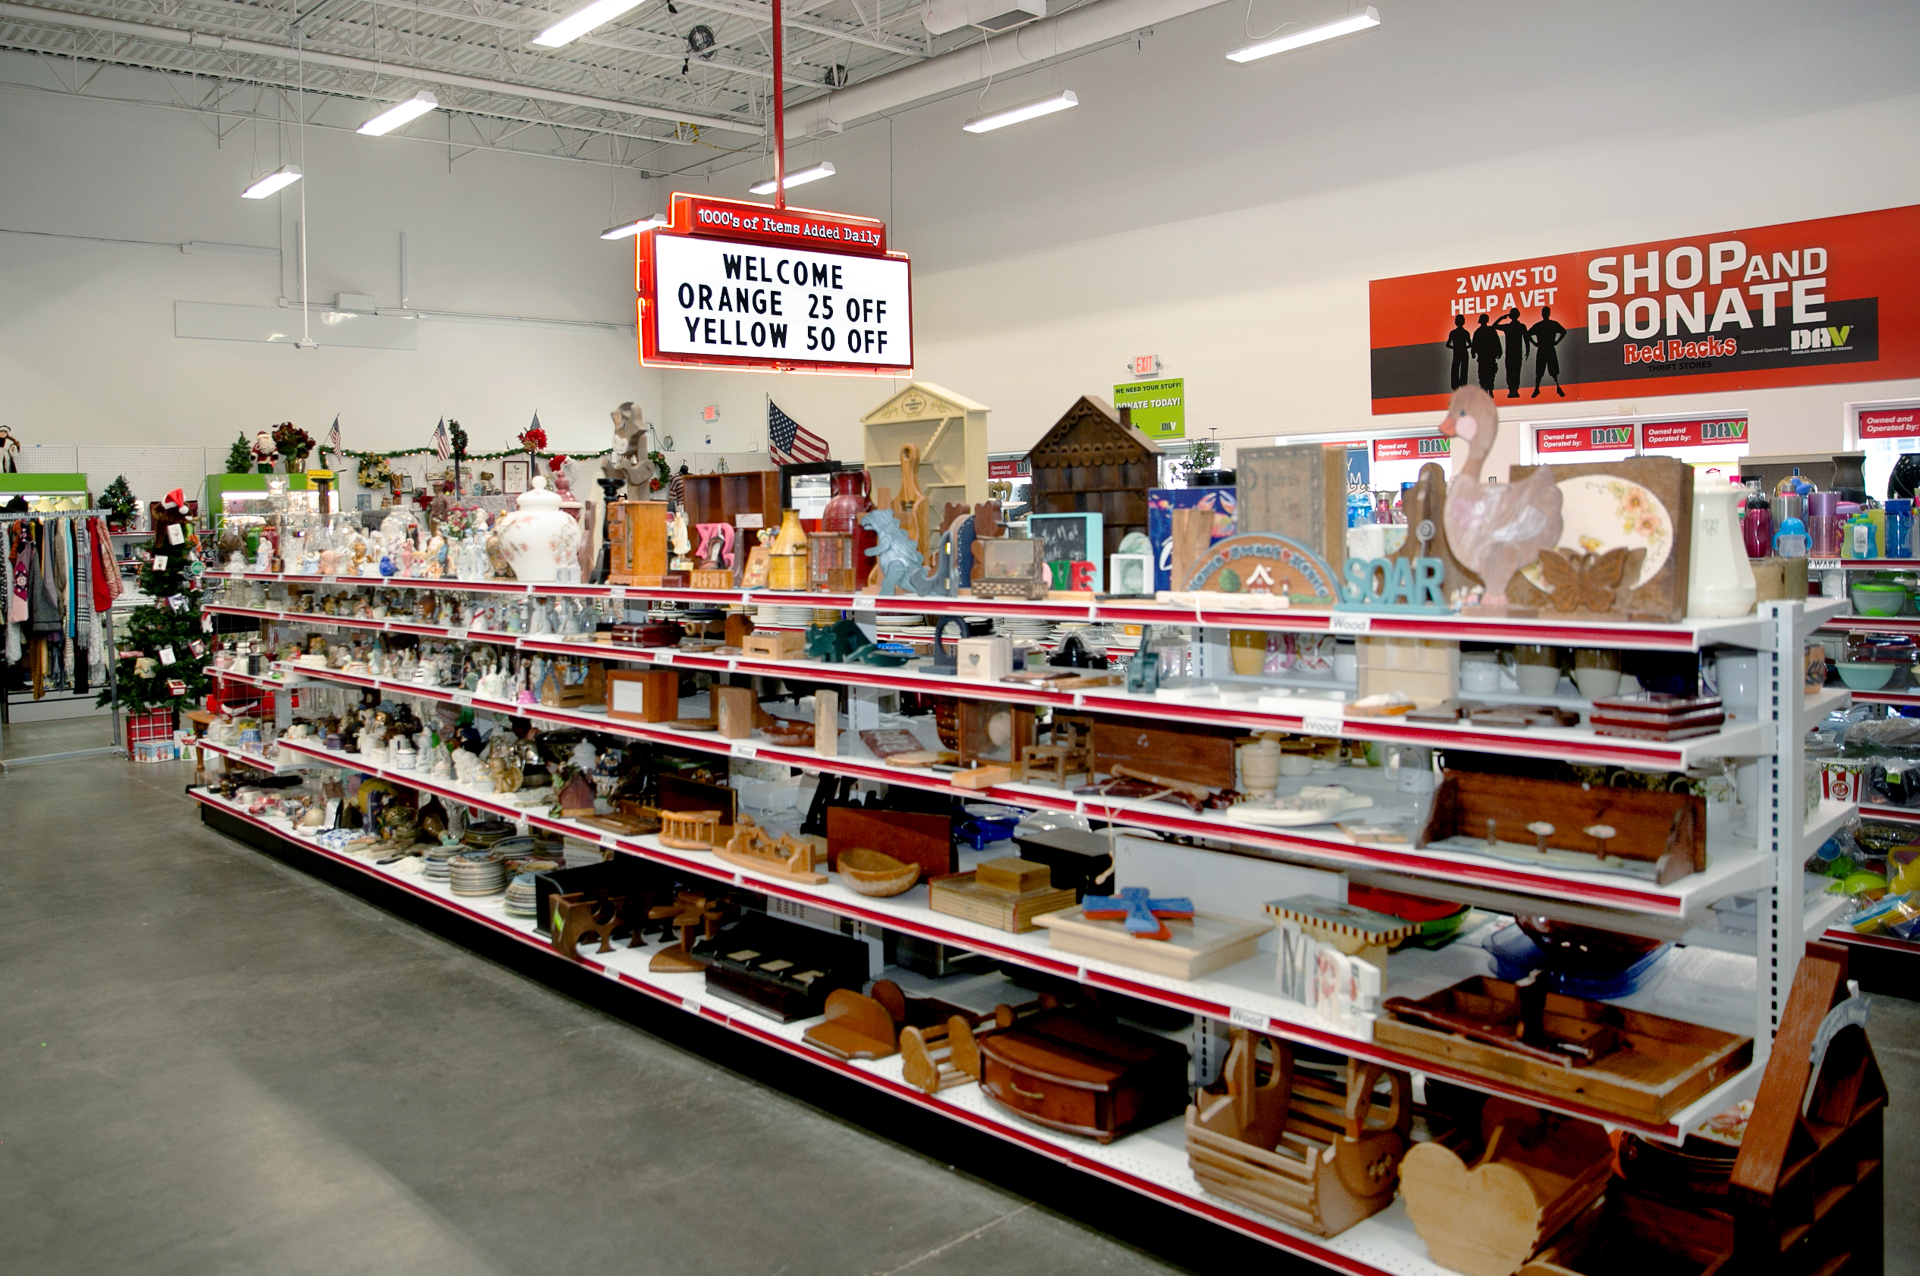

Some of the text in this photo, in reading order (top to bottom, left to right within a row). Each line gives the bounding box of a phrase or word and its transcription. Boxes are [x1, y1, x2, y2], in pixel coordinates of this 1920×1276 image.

[698, 208, 881, 247] 1000's of Items Added Daily
[722, 253, 843, 290] WELCOME
[1588, 240, 1828, 299] SHOP AND
[1456, 265, 1557, 294] 2 WAYS TO
[678, 282, 887, 324] ORANGE 25 OFF
[1451, 287, 1558, 316] HELP A VET
[1588, 277, 1827, 344] DONATE
[684, 316, 888, 354] YELLOW 50 OFF
[1790, 325, 1851, 350] DAV
[1624, 335, 1737, 365] Red Racks
[1136, 356, 1153, 373] EXIT
[1648, 360, 1713, 373] THRIFT STORES
[1160, 382, 1182, 390] STUFF!
[1116, 398, 1182, 410] DONATE TODAY!
[1866, 416, 1895, 424] Owned
[1867, 425, 1904, 433] Operated
[1591, 427, 1632, 444] DAV
[1648, 435, 1679, 443] Operated
[1701, 421, 1746, 439] DAV
[1543, 440, 1571, 448] Operated
[1341, 557, 1446, 604] SOAR
[1333, 619, 1366, 630] Wood
[1233, 1009, 1263, 1027] Wood
